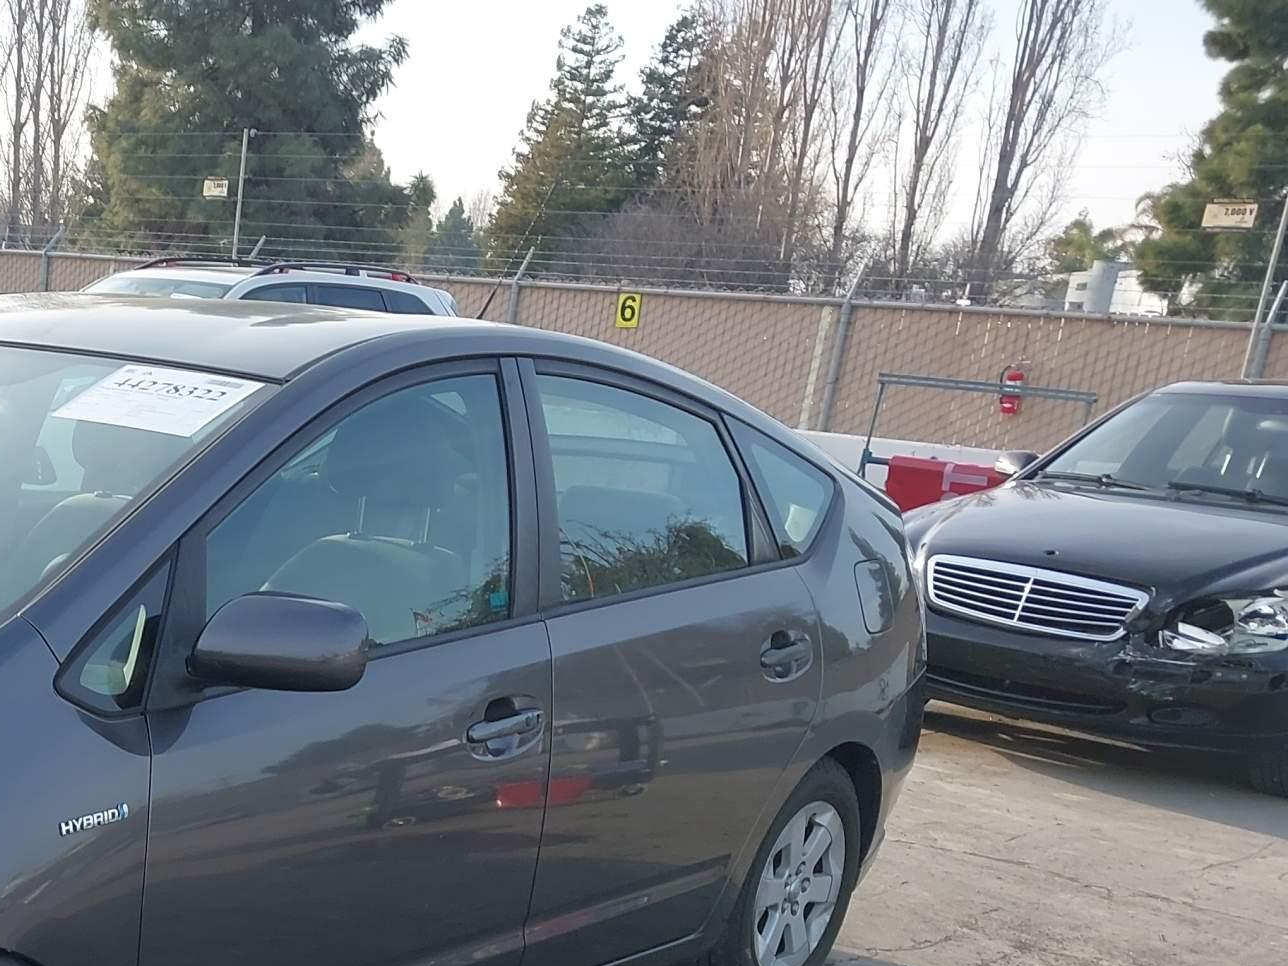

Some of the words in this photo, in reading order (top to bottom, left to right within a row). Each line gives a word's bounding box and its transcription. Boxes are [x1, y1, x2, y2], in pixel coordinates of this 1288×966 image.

[620, 295, 636, 322] 6
[114, 377, 228, 401] 44278322
[59, 808, 119, 837] HYBRID
